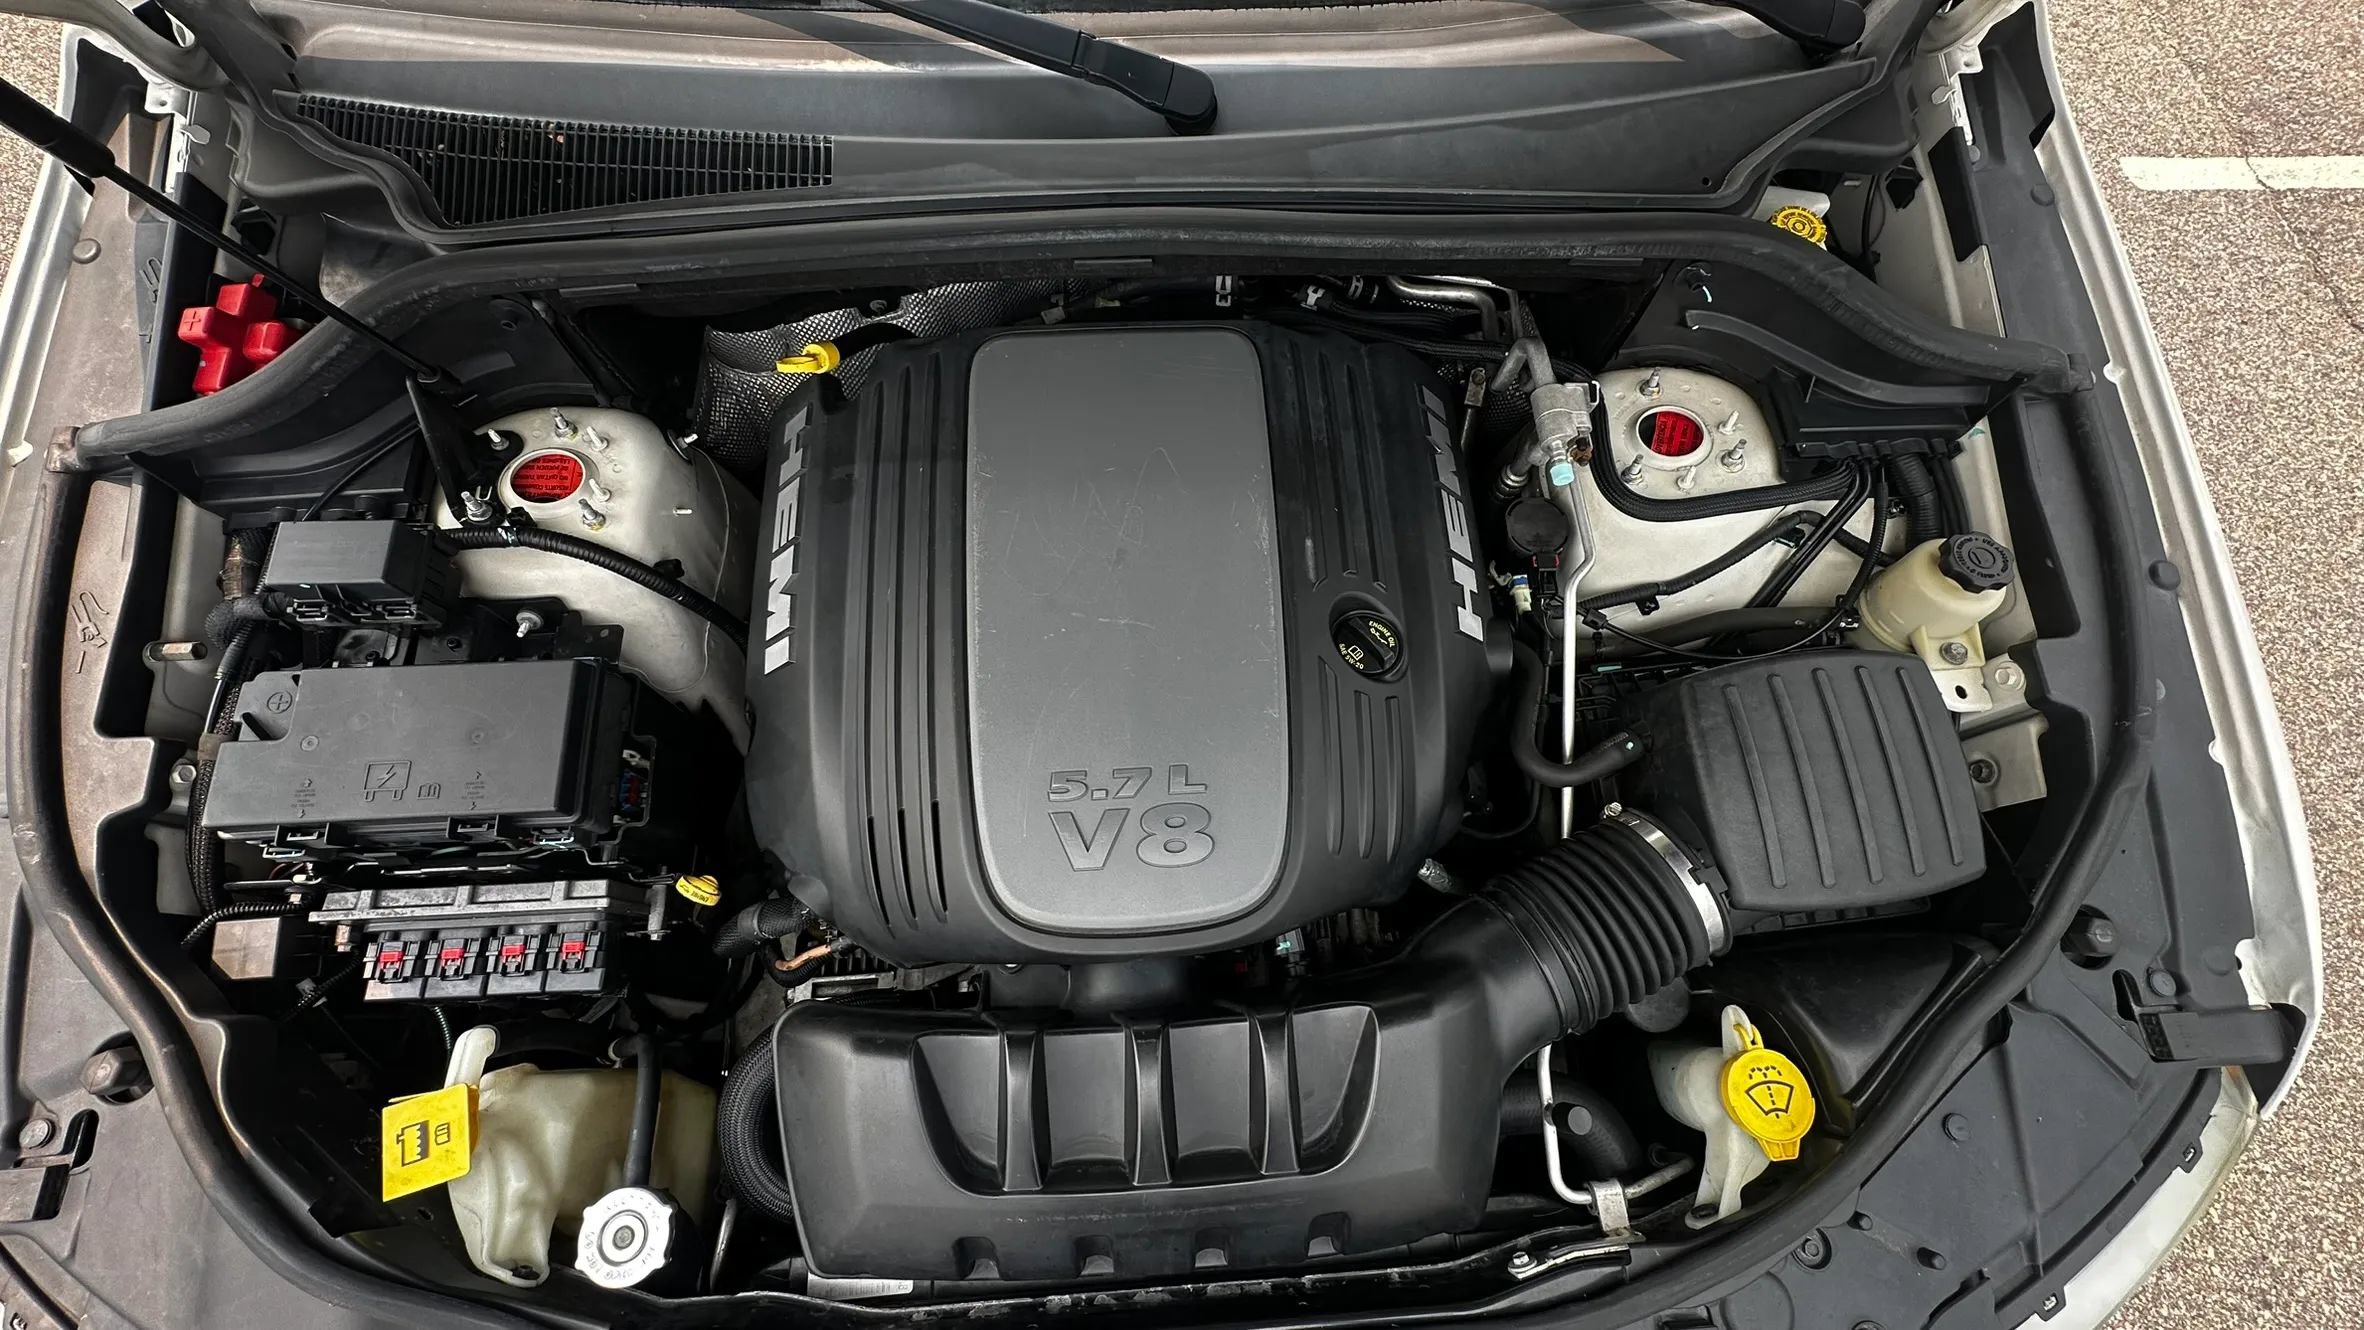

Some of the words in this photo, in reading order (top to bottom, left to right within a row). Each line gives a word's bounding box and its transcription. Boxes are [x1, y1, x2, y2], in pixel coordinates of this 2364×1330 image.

[764, 405, 809, 675] HEMI
[1420, 385, 1484, 643] HEMI
[1369, 621, 1391, 637] ENGINE
[1339, 643, 1347, 655] SAE
[1344, 655, 1364, 670] 5W-20
[1048, 767, 1152, 802] 5.7
[1168, 764, 1208, 795] L
[1048, 802, 1216, 871] V8
